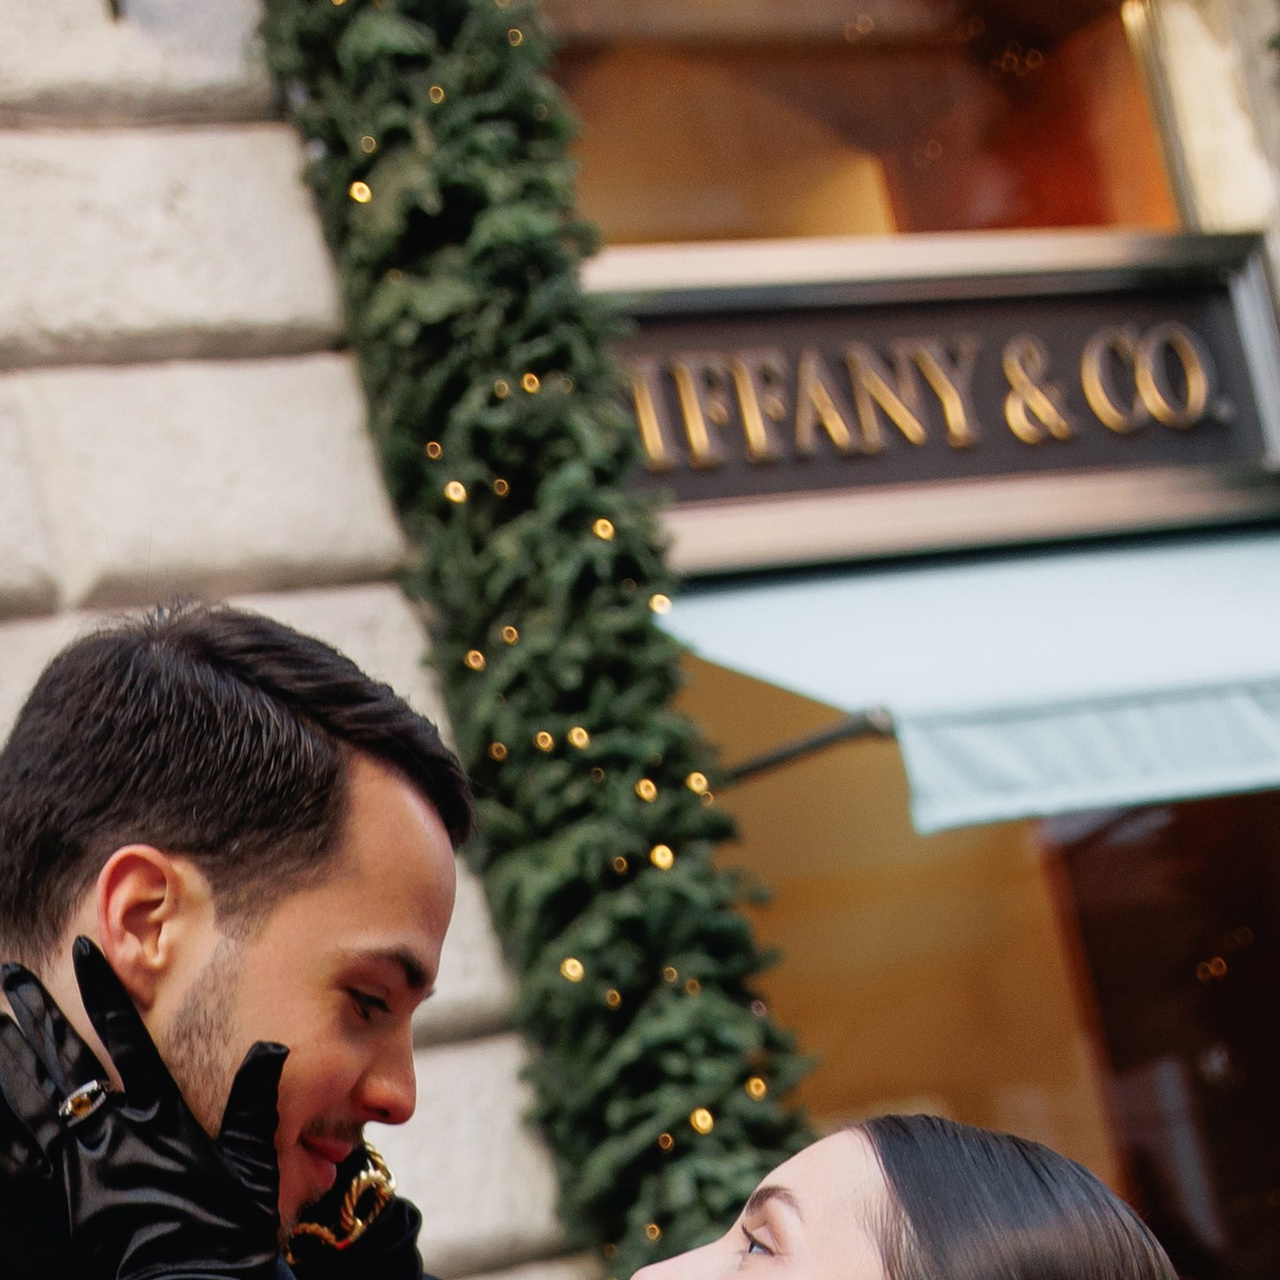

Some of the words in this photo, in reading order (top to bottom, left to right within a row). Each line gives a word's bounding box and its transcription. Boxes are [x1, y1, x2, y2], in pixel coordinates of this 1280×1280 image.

[622, 333, 983, 473] IFFANY
[1001, 332, 1074, 445] &
[1080, 321, 1236, 434] CO.
